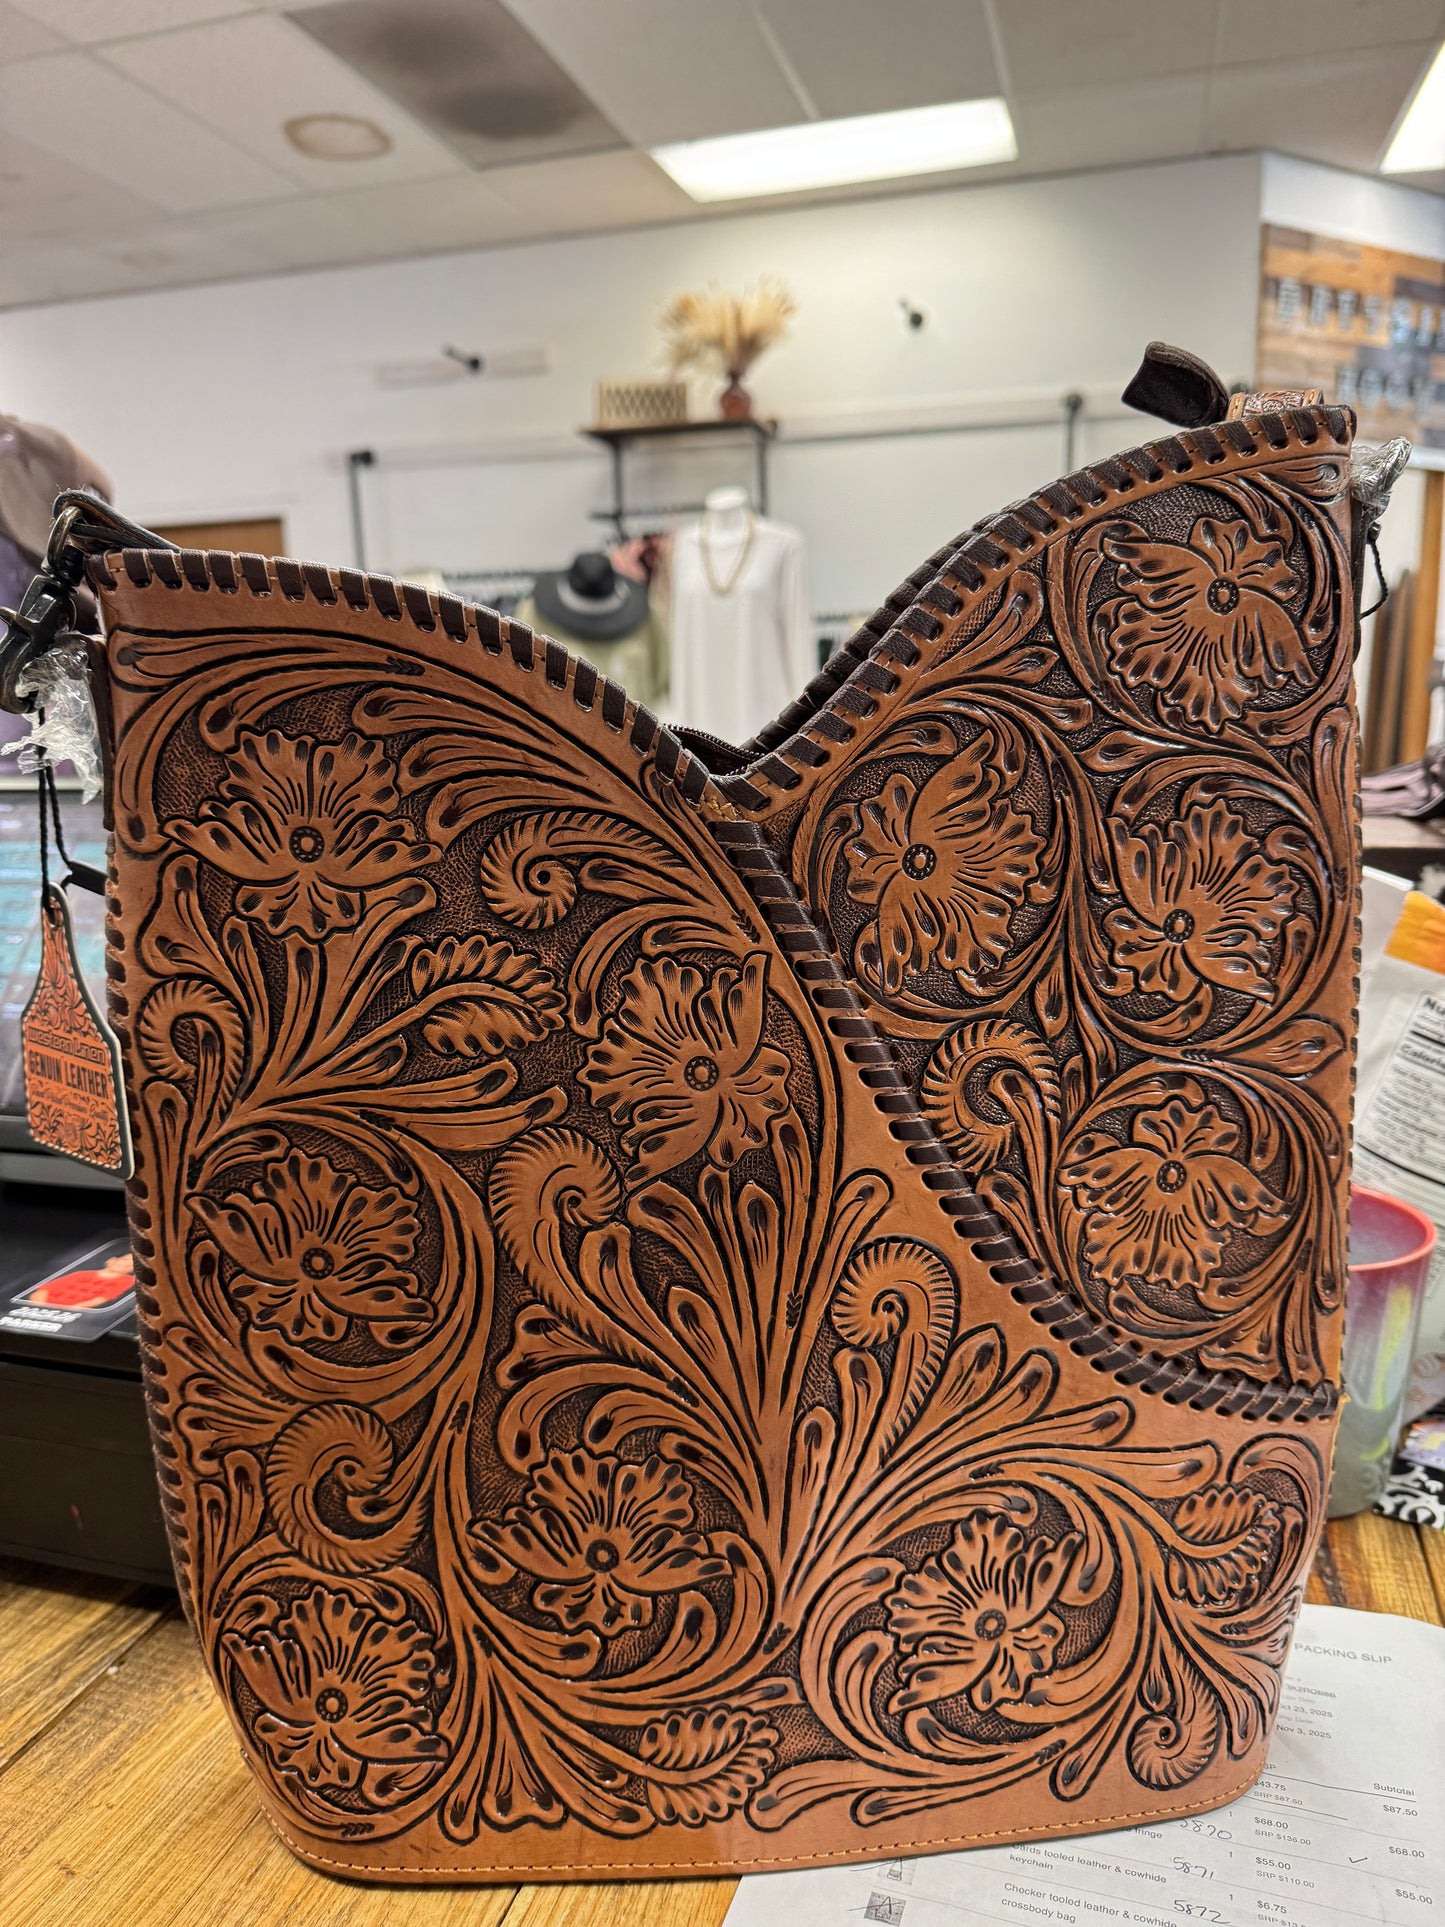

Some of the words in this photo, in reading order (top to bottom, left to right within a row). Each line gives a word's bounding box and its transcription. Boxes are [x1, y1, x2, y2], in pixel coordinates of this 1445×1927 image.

[64, 1061, 109, 1100] LEATHER
[1294, 1642, 1357, 1660] PACKING
[1361, 1653, 1392, 1664] SLIP
[1310, 1708, 1333, 1718] 2025
[1276, 1724, 1294, 1733] Nov
[1308, 1729, 1332, 1740] 2025
[1373, 1782, 1415, 1797] Subtotal
[1383, 1804, 1418, 1817] $87.50
[1254, 1816, 1289, 1830] $68.00
[1254, 1829, 1274, 1838] SRP
[1276, 1832, 1312, 1846] $136.00
[1388, 1846, 1426, 1859] $68.00
[1009, 1853, 1054, 1870] keychain
[1044, 1849, 1075, 1863] tooled
[1077, 1856, 1111, 1871] leather
[1114, 1865, 1122, 1874] &
[1124, 1868, 1167, 1884] cowhide
[1172, 1856, 1214, 1880] 5871
[1255, 1856, 1291, 1871] $55.00
[1256, 1870, 1276, 1879] SRP
[1278, 1874, 1315, 1889] $110.00
[1004, 1882, 1047, 1899] Checker
[1049, 1893, 1081, 1907] tooled
[1083, 1900, 1119, 1916] leather
[1122, 1910, 1130, 1920] &
[1133, 1914, 1177, 1927] cowhide
[1395, 1888, 1433, 1905] $55.00
[1001, 1898, 1054, 1918] crossbody
[1056, 1910, 1077, 1925] bag
[1173, 1899, 1232, 1924] 5872
[1257, 1900, 1288, 1914] $6.75
